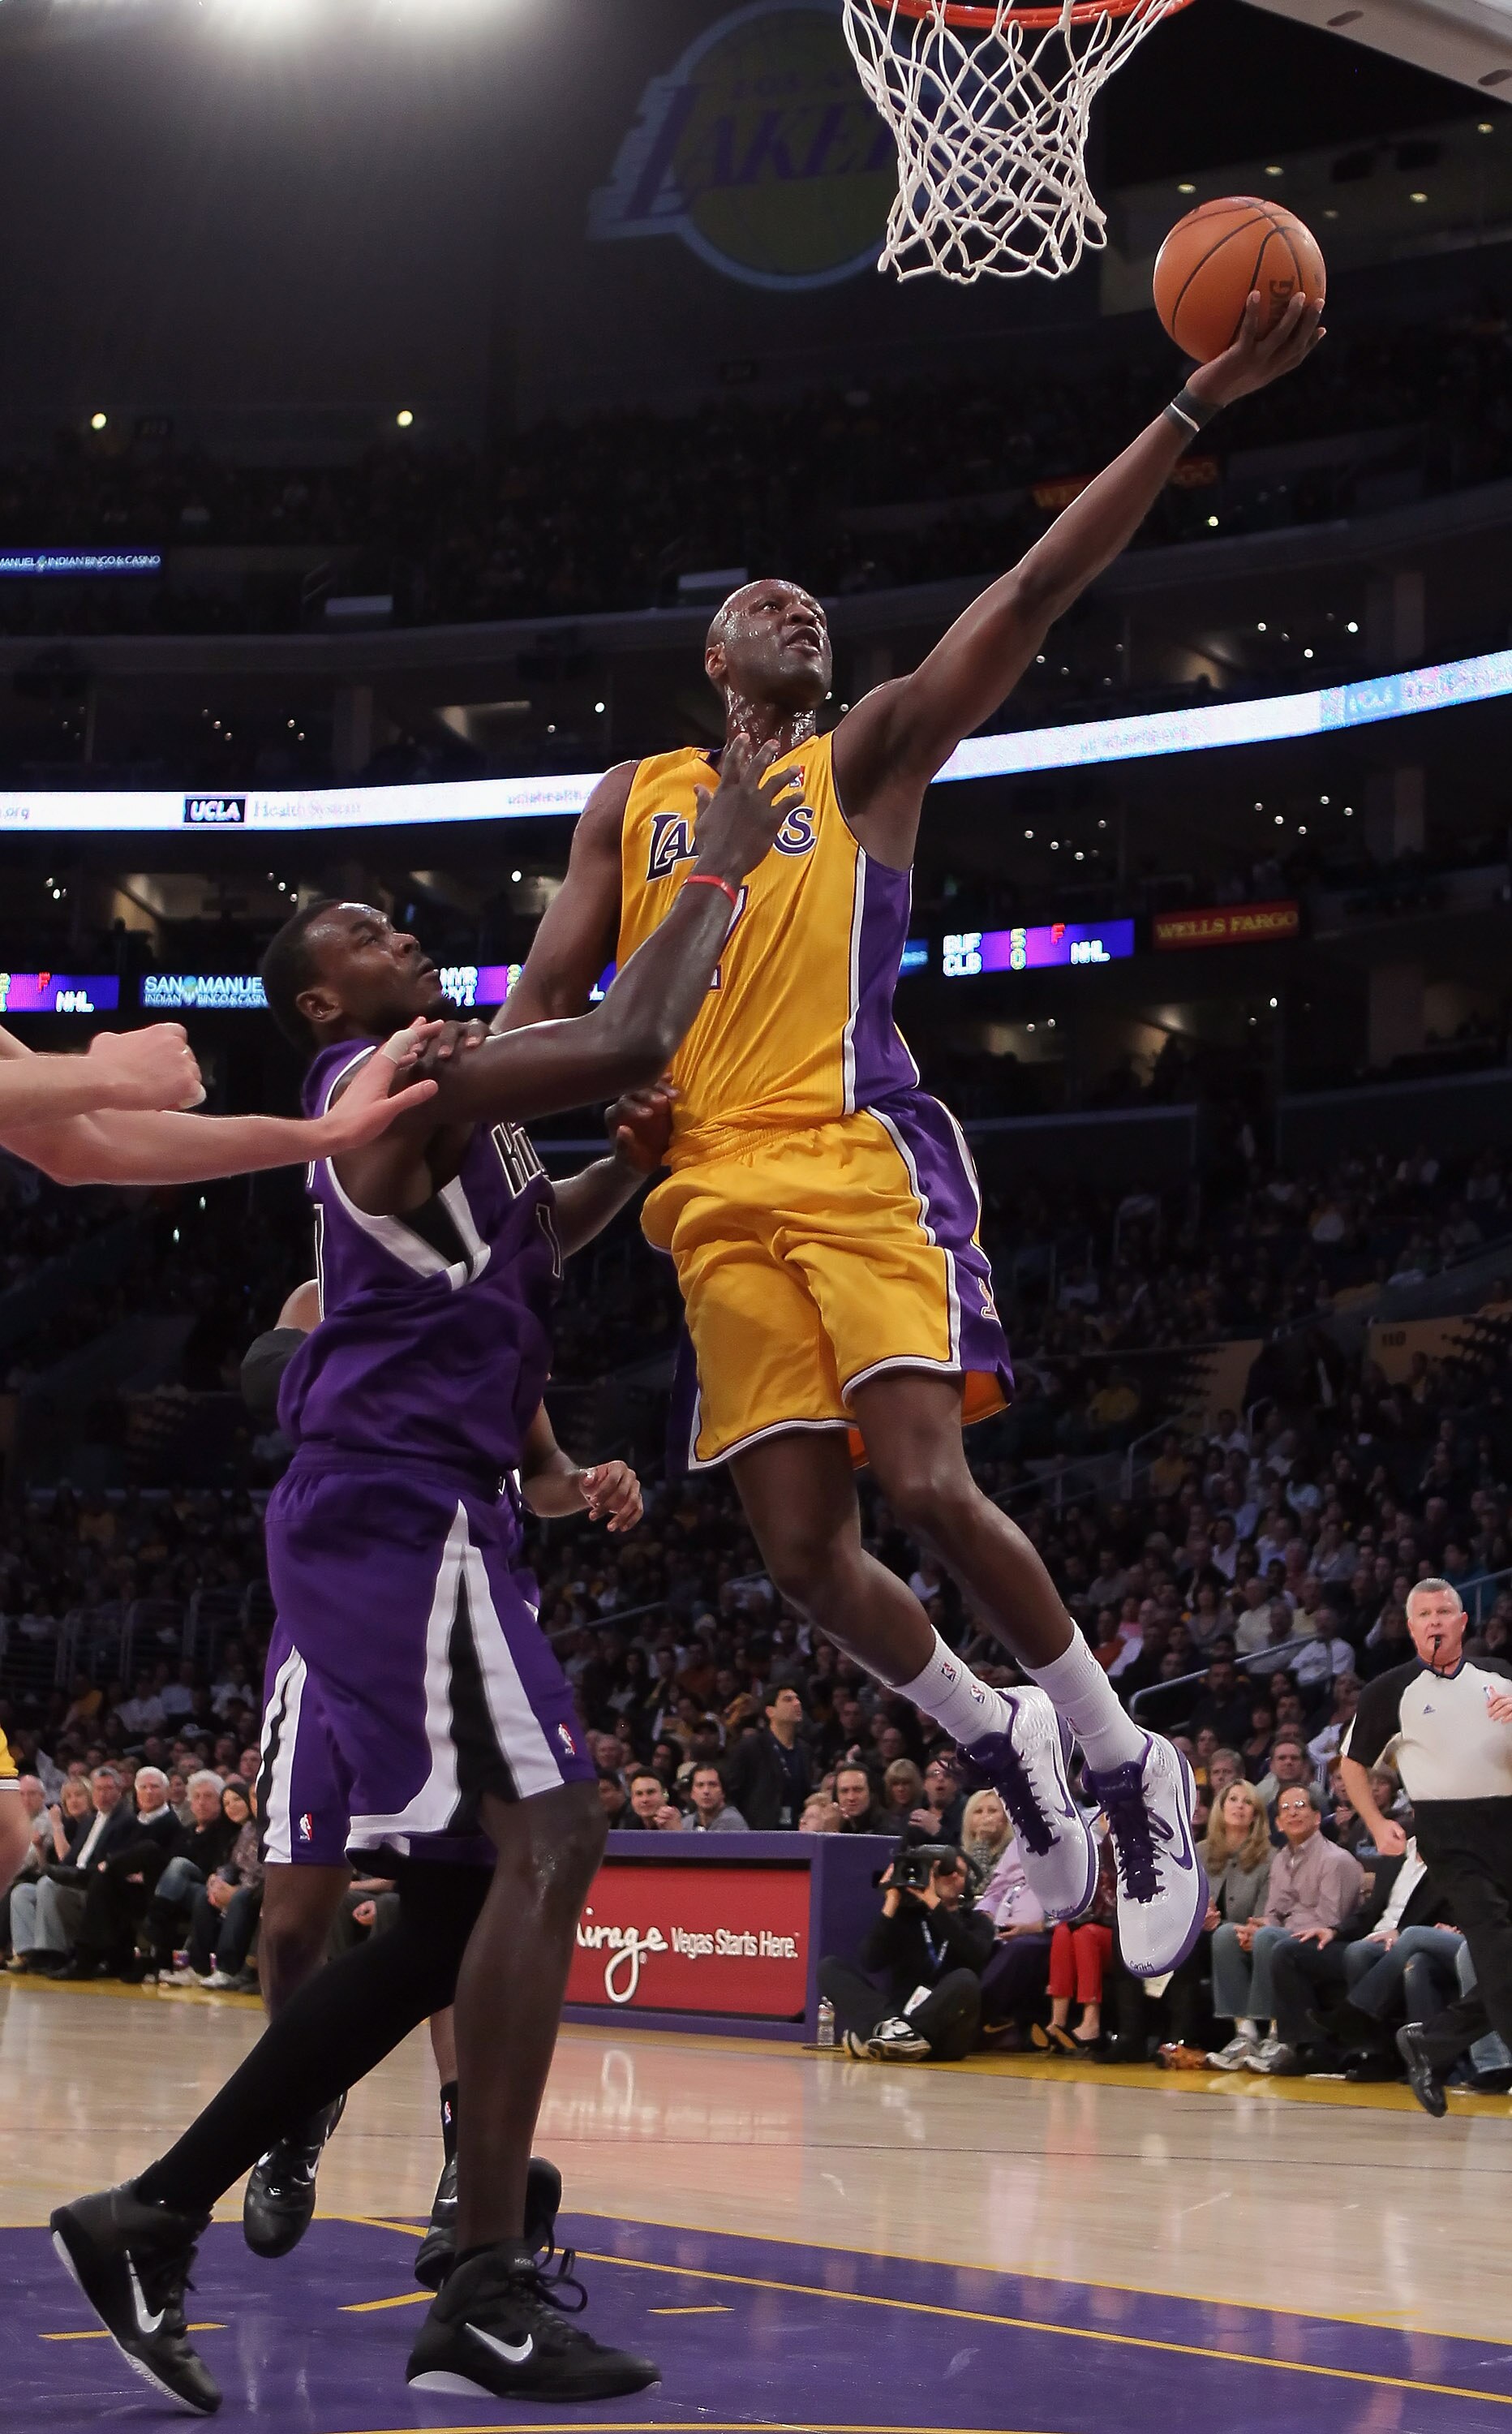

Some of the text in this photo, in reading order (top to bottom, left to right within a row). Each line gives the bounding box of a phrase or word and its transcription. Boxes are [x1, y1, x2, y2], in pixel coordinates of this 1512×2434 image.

[48, 557, 83, 565] INDIAN
[85, 556, 115, 566] BINGO
[125, 555, 161, 565] CASINO
[190, 800, 241, 822] UCLA
[1157, 910, 1298, 939] WELLS FARGO
[943, 932, 982, 956] BUF
[1051, 922, 1065, 944] F
[943, 953, 982, 976] CLB
[1071, 940, 1110, 964] NHL
[38, 972, 50, 991] F
[144, 976, 264, 993] SAN MANUE
[56, 991, 94, 1012] NHL
[144, 994, 181, 1004] INDIAN
[198, 994, 228, 1004] BINGO
[237, 995, 267, 1004] CASIN
[670, 1926, 713, 1959] Vegas
[715, 1928, 758, 1957] Starts
